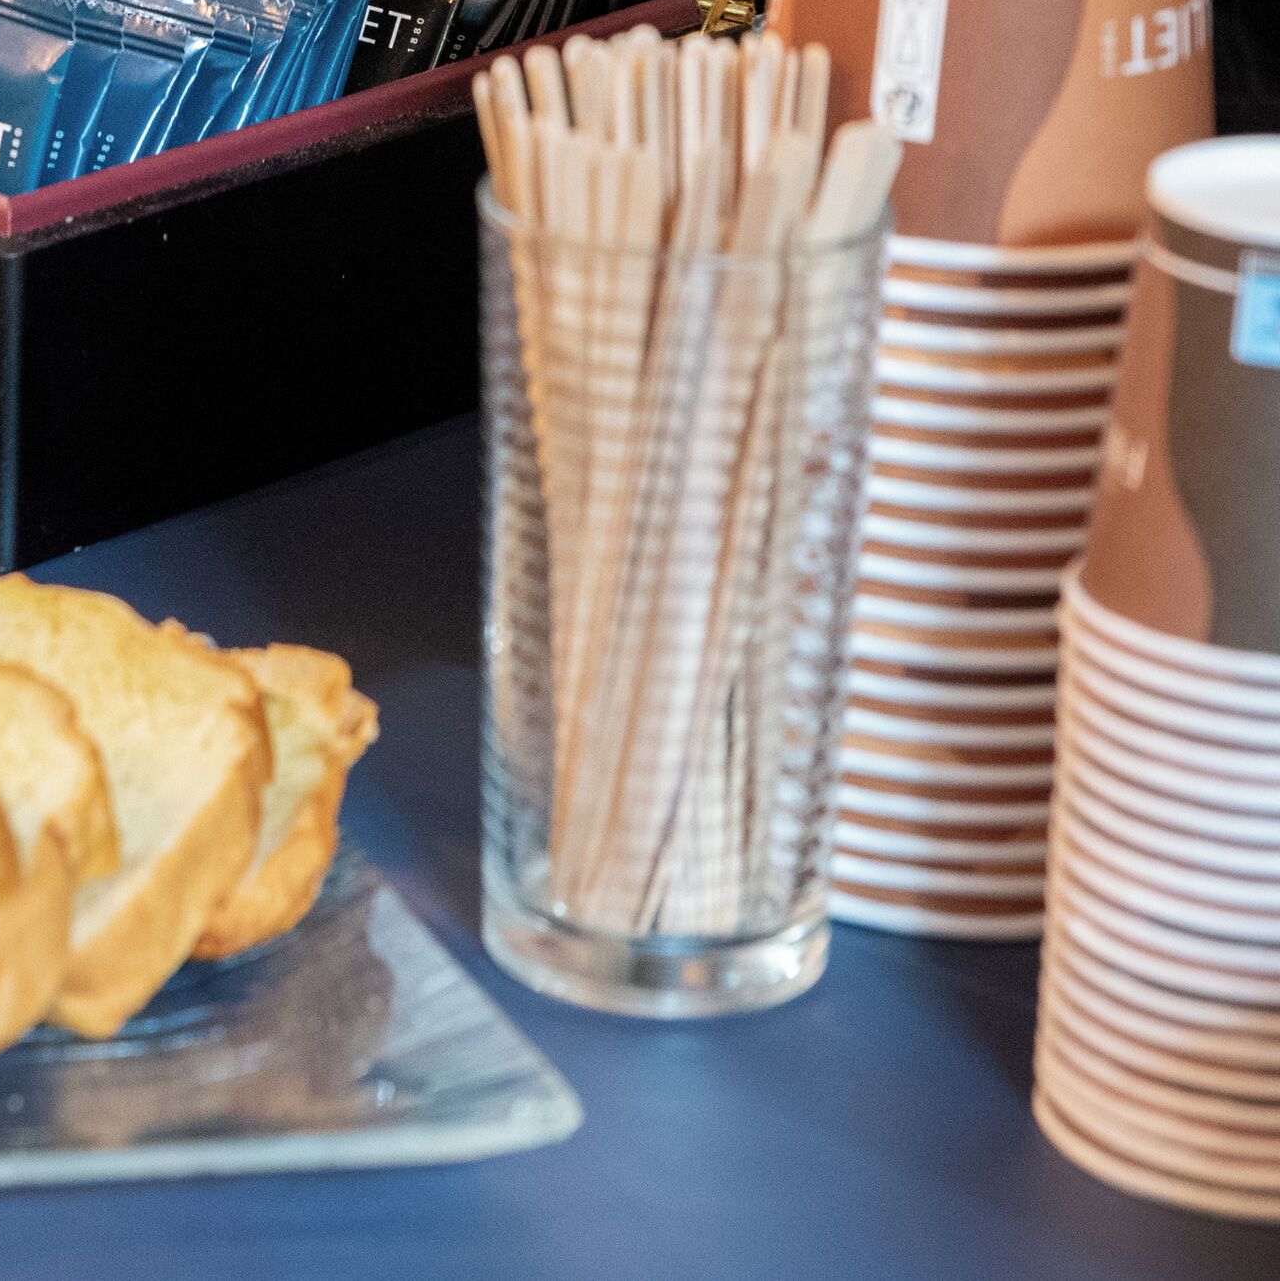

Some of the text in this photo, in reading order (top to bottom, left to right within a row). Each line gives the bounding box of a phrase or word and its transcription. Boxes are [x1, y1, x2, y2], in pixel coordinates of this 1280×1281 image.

[407, 17, 425, 53] 1880
[449, 34, 466, 60] 880
[7, 126, 23, 168] 1880
[47, 130, 65, 169] 1880
[93, 133, 115, 171] 1880
